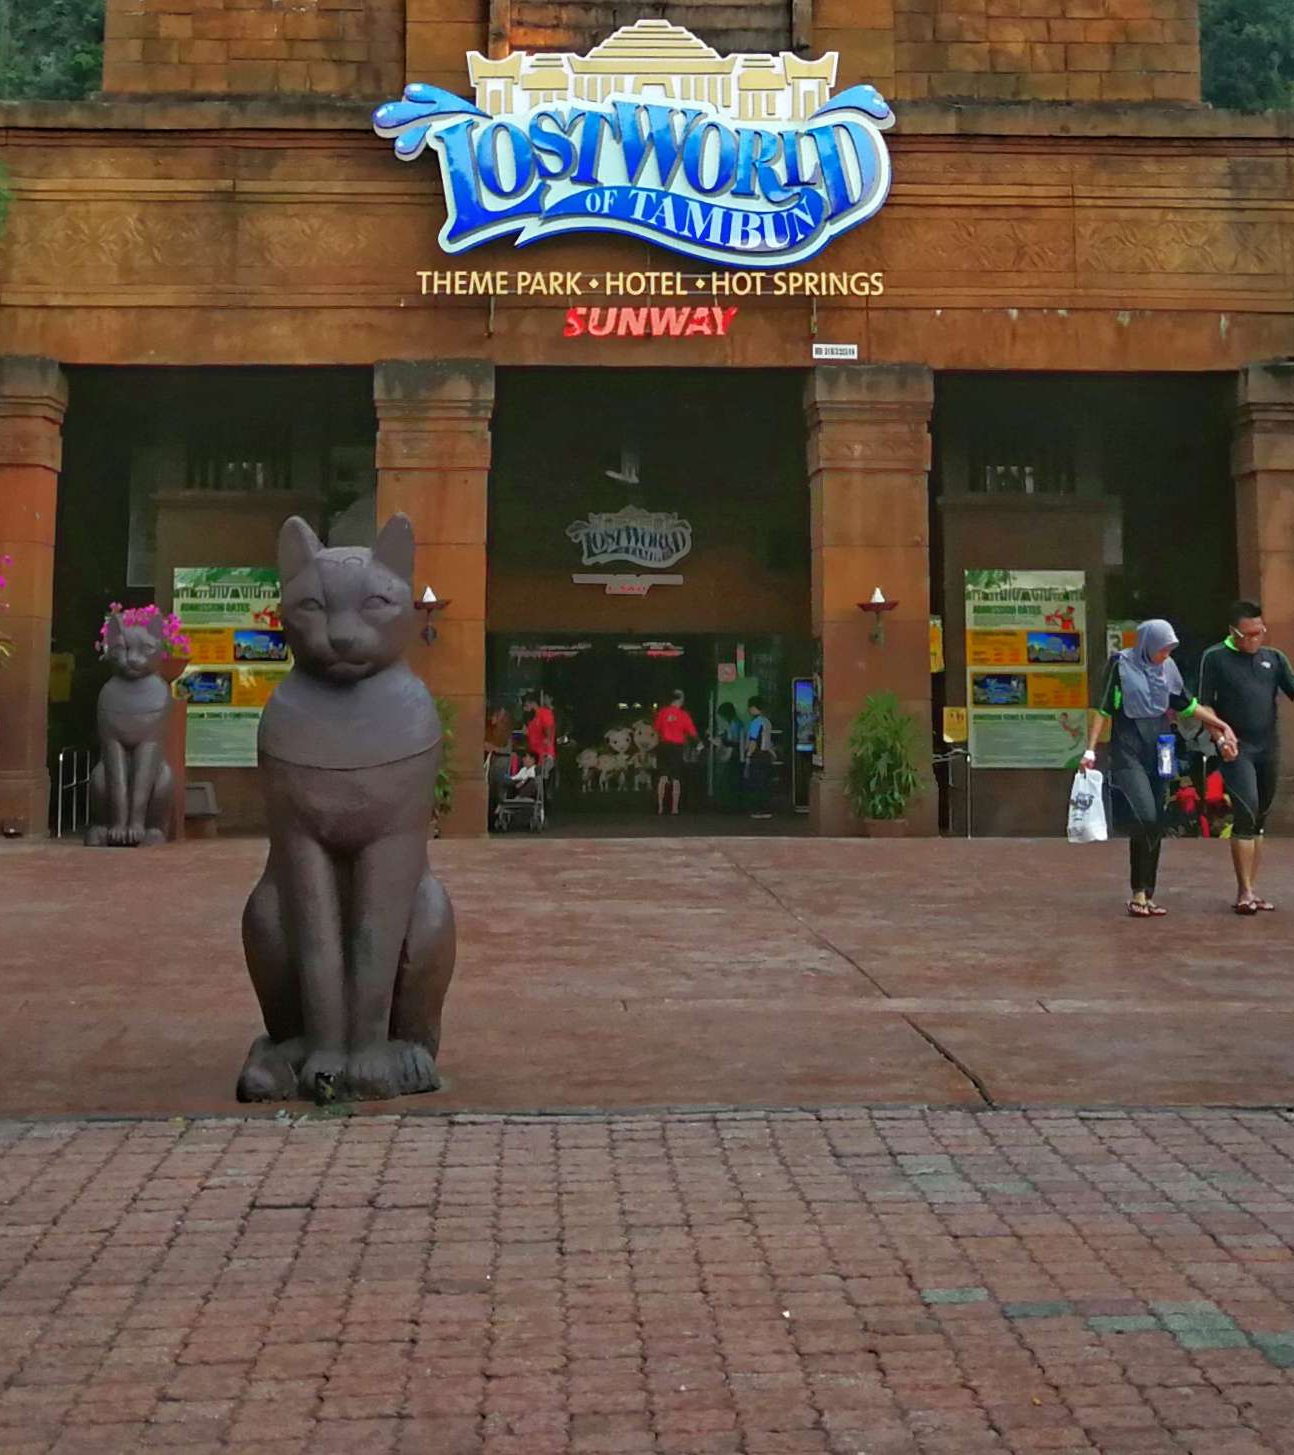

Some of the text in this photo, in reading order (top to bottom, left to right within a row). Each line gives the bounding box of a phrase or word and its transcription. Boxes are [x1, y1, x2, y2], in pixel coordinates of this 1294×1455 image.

[434, 101, 878, 240] LOST WORLD
[585, 189, 818, 249] OF TAMBUN
[417, 271, 885, 296] THEME PARK HOTEL HOT SPRINGS
[562, 306, 739, 338] SUNWAY
